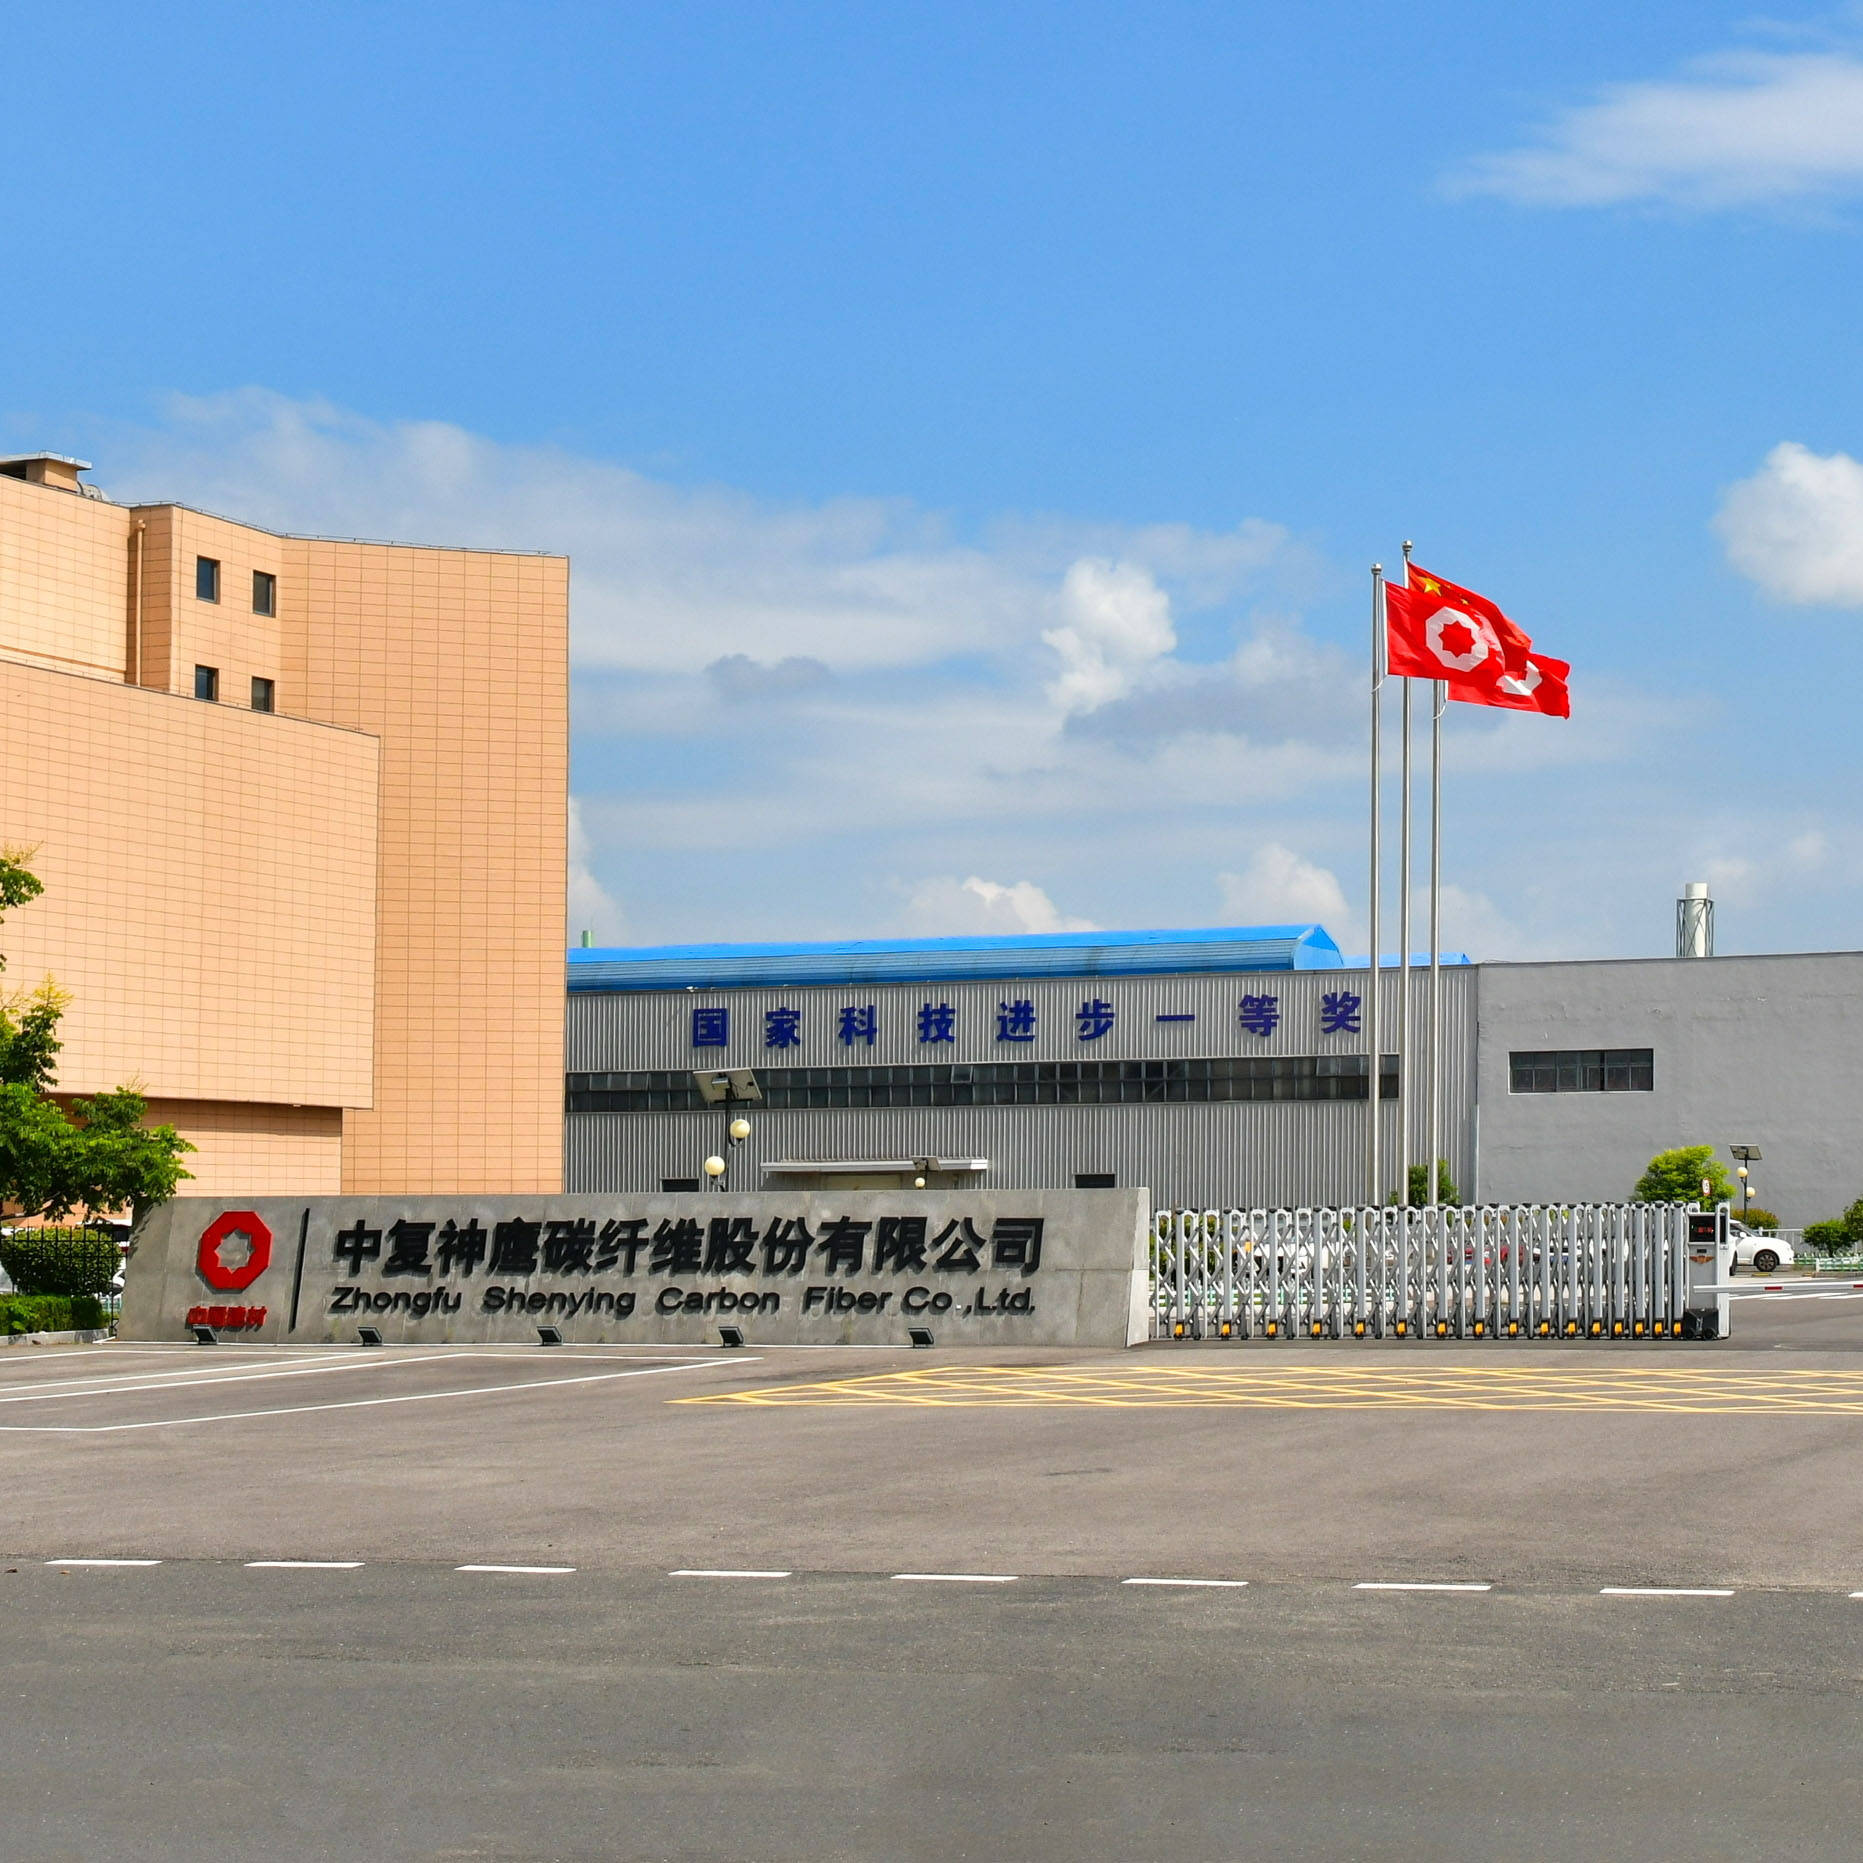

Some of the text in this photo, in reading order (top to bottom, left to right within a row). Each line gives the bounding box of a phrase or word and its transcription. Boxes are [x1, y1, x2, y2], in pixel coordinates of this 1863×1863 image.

[692, 991, 1362, 1049] 国家科技进步一等奖
[333, 1216, 1045, 1278] 中复神鹰碳纤维股份有限公司
[330, 1286, 462, 1319] Zhongfu
[483, 1286, 637, 1320] Shenying
[656, 1286, 781, 1315] Carbon
[803, 1286, 893, 1315] Fiber
